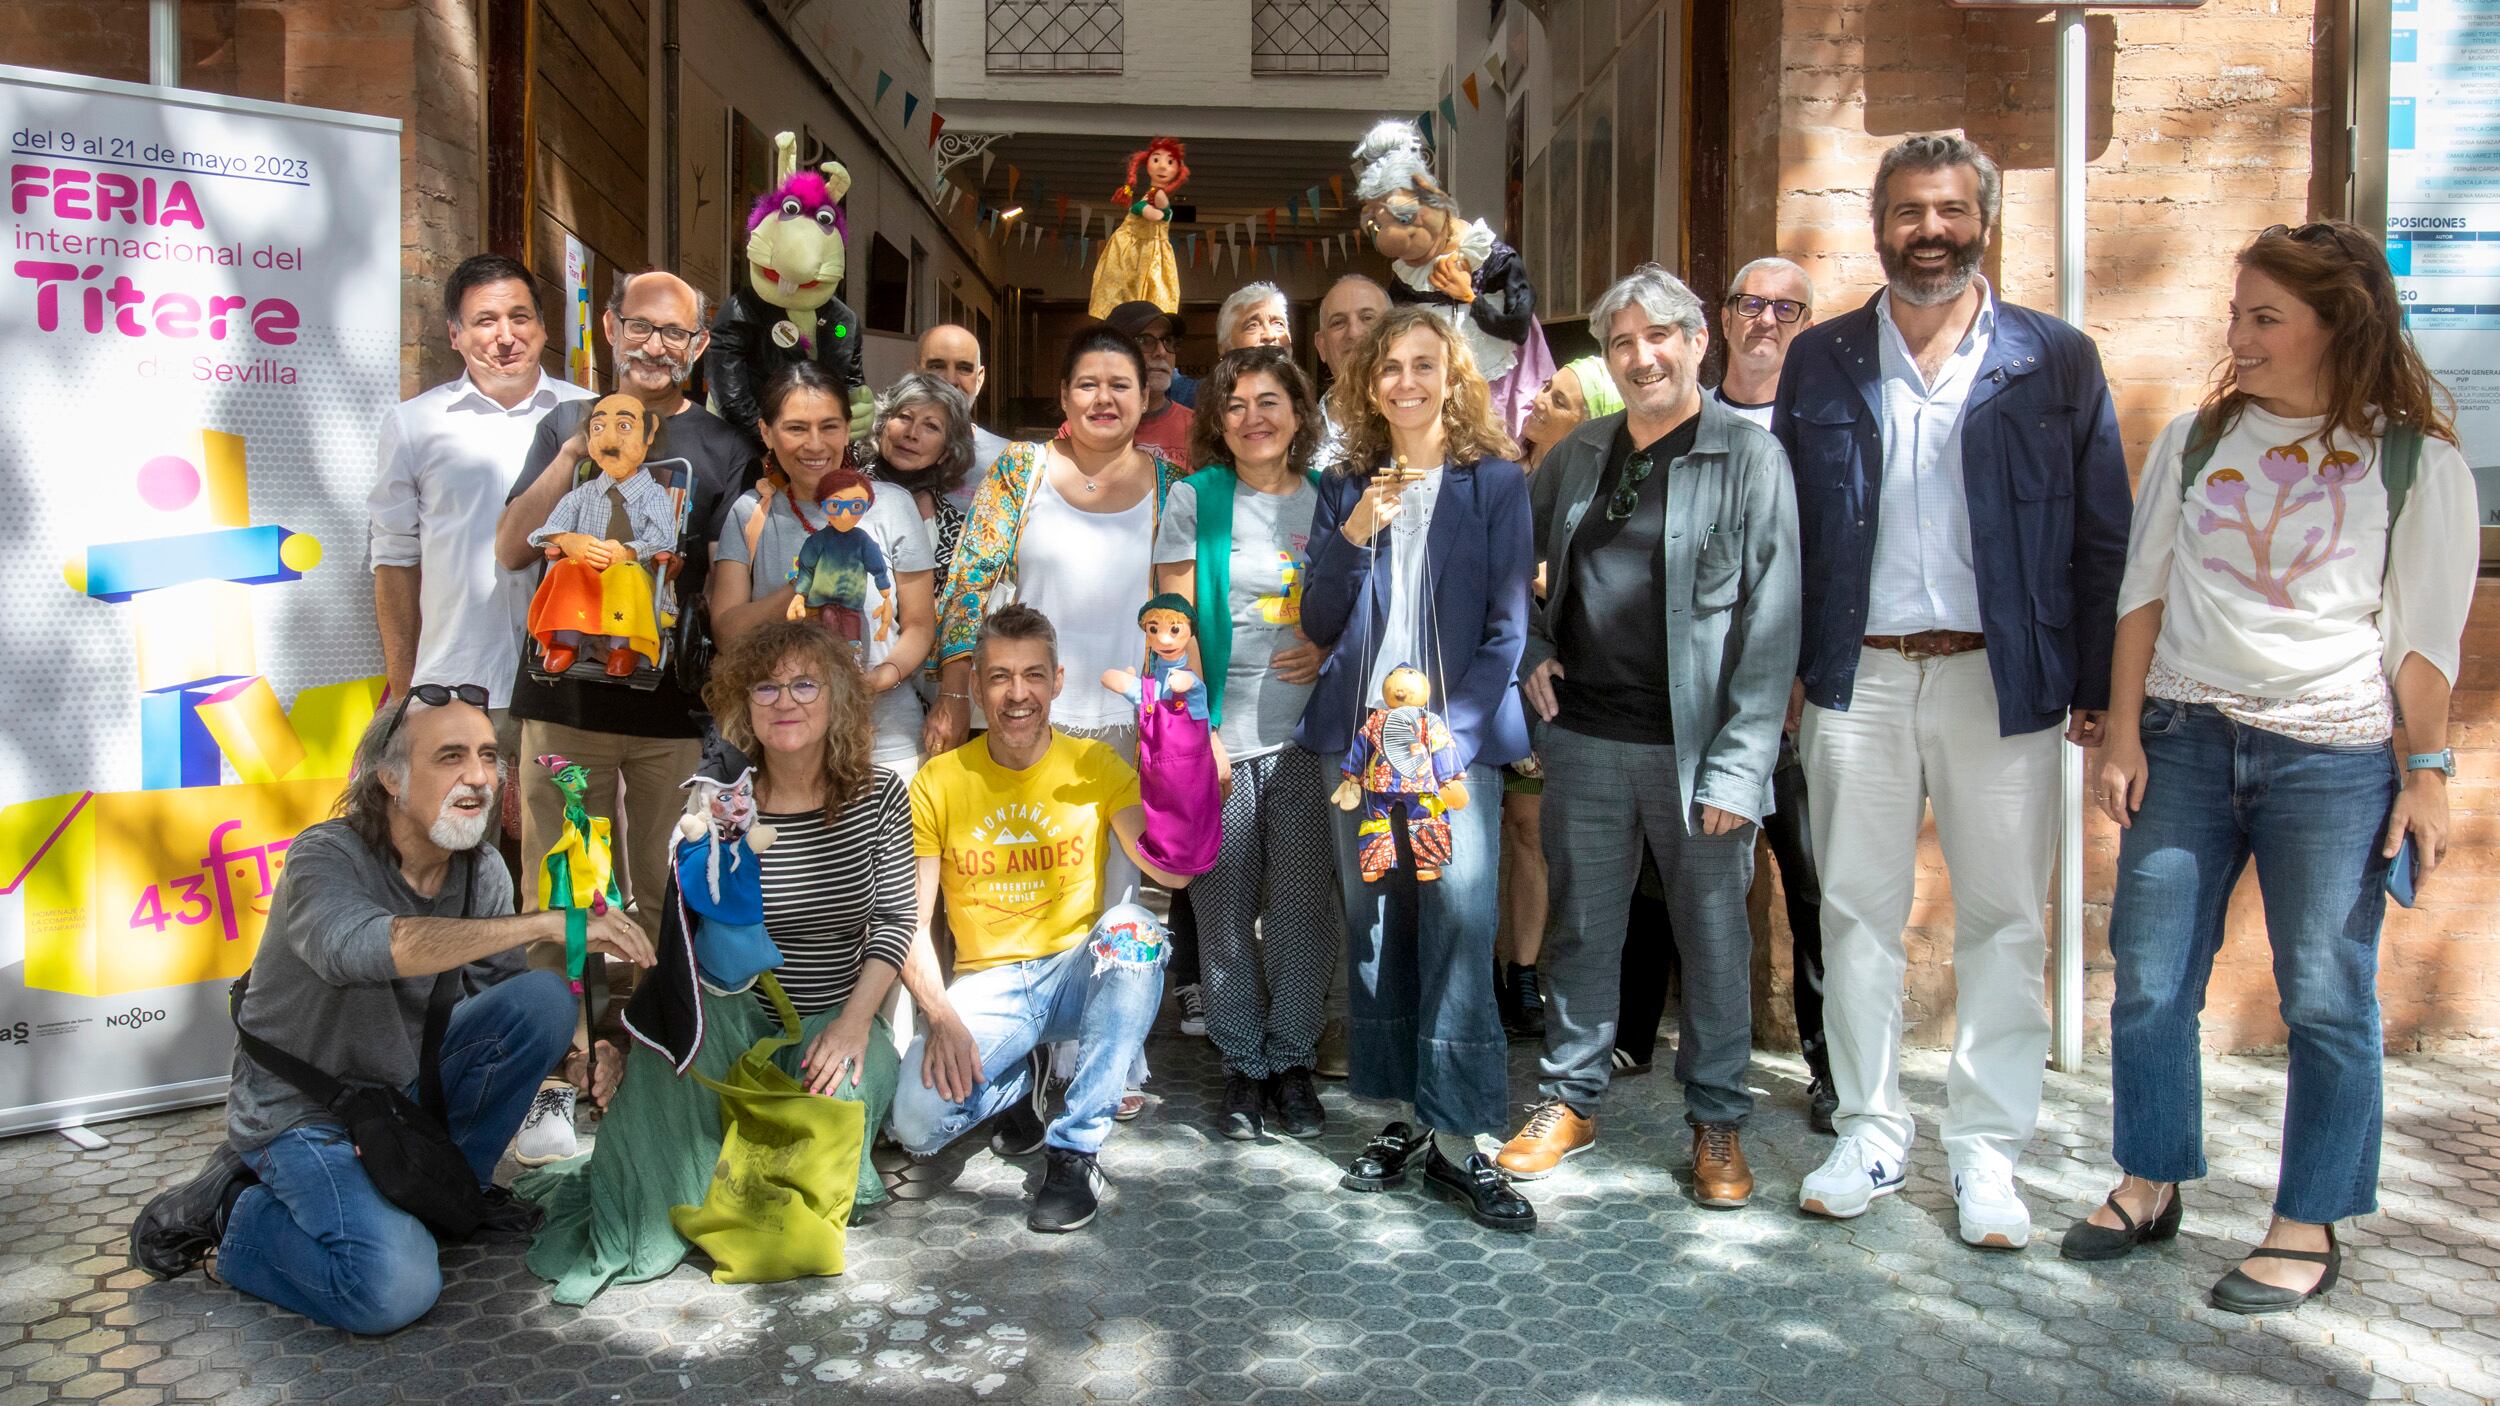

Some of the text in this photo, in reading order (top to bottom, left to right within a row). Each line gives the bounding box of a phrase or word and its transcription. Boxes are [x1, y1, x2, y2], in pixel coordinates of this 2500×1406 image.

[12, 128, 309, 179] del 9 al 21 de mayo 2023
[11, 164, 205, 230] FERIA
[2387, 217, 2467, 229] XPOSICIONES
[15, 224, 302, 271] internacional del
[14, 260, 301, 345] Títere
[192, 356, 298, 384] Sevilla
[971, 802, 1063, 842] MONTAÑAS
[952, 836, 1085, 877] LOS ANDES
[989, 880, 1046, 892] ARGENTINA
[1008, 892, 1036, 904] CHILE
